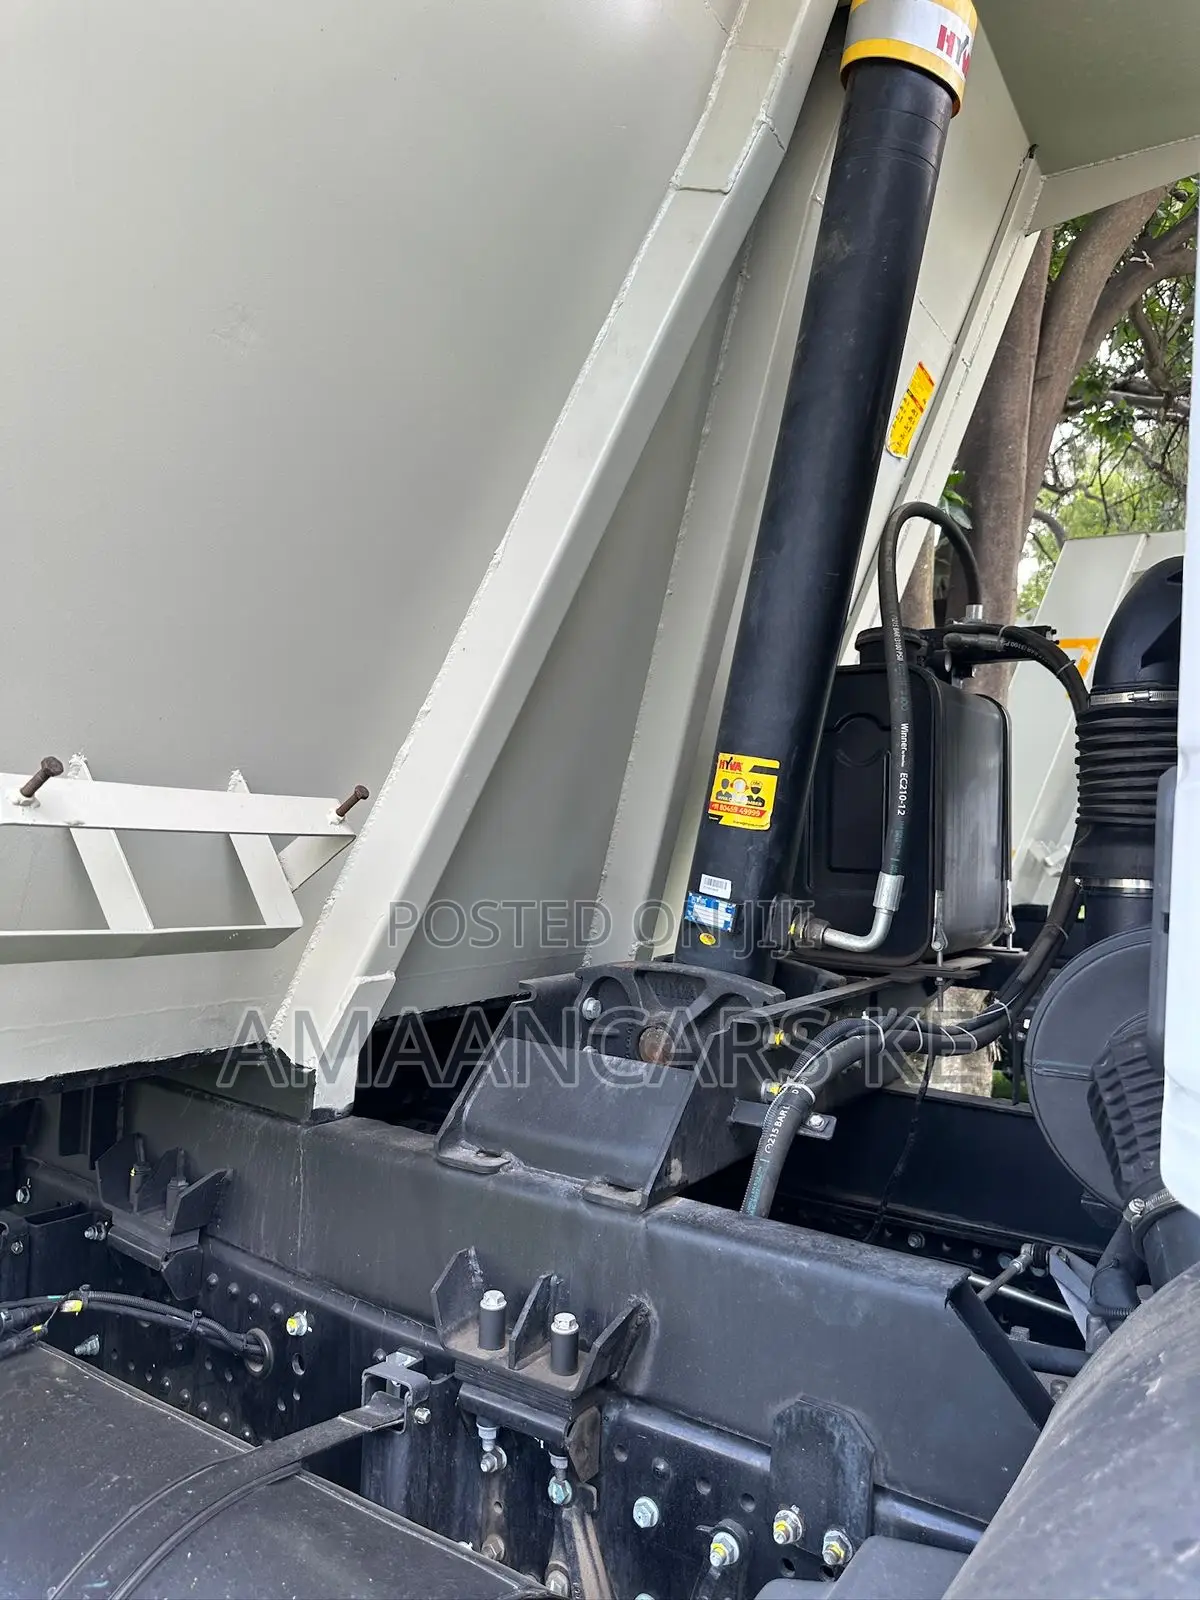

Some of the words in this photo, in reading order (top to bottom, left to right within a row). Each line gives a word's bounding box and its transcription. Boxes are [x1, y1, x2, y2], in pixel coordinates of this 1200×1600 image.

[900, 722, 909, 751] Winner
[719, 757, 742, 772] HYVA
[897, 772, 909, 816] EC210-12
[770, 1127, 779, 1144] 215
[776, 1109, 788, 1127] BAR
